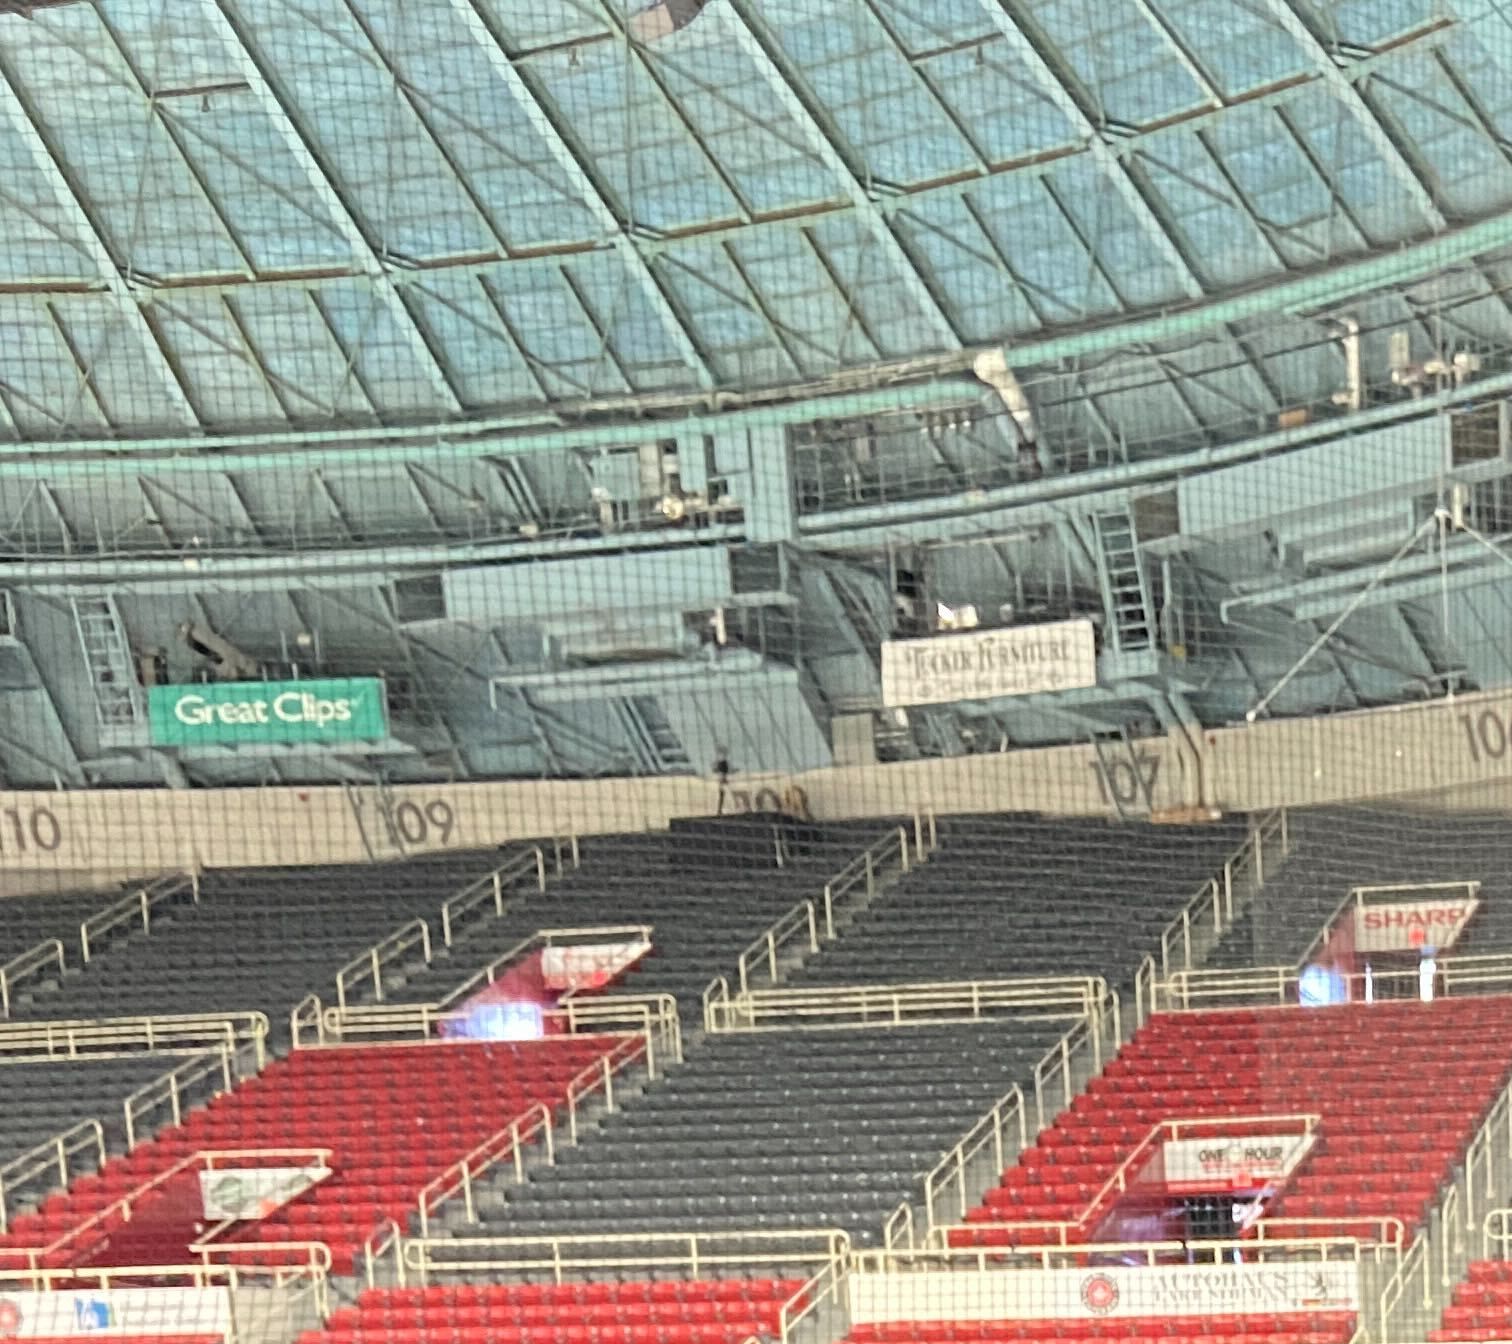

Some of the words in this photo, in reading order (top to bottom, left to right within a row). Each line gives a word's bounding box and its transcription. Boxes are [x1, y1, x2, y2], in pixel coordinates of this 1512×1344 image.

[174, 693, 268, 725] Great
[273, 691, 353, 728] Clips
[0, 807, 62, 852] 10
[1363, 907, 1466, 930] SHARP
